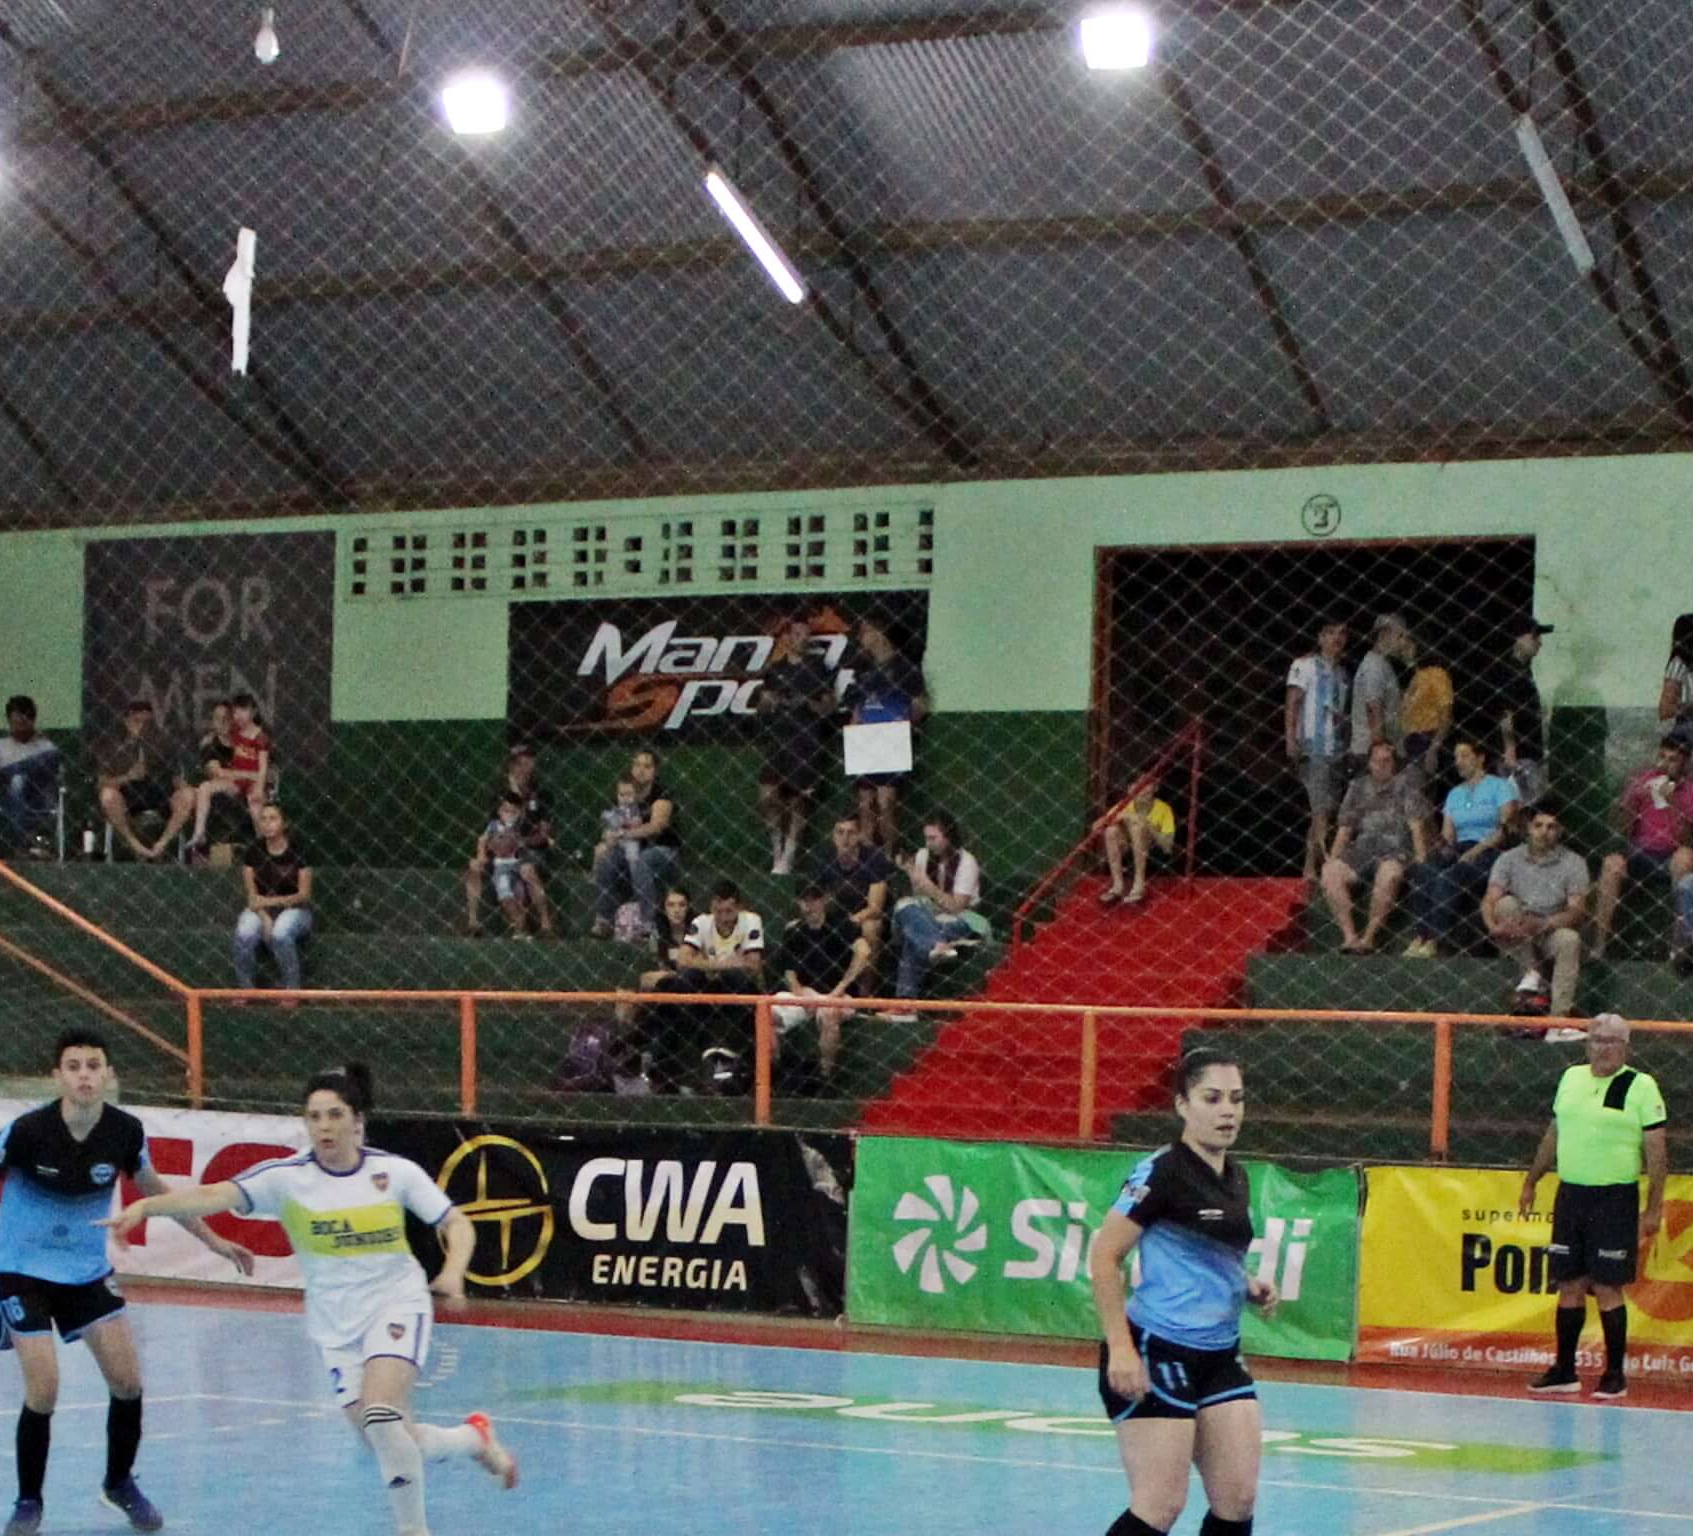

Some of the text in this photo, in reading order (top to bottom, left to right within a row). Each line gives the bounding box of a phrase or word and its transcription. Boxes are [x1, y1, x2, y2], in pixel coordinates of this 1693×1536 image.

[142, 571, 275, 646] FOR
[576, 618, 850, 689] Mana
[136, 658, 277, 734] MEN
[568, 1157, 766, 1247] CWA
[592, 1254, 748, 1292] ENERGIA
[1003, 1197, 1313, 1302] Sidi
[1460, 1232, 1560, 1295] Pon
[1463, 1345, 1483, 1361] de
